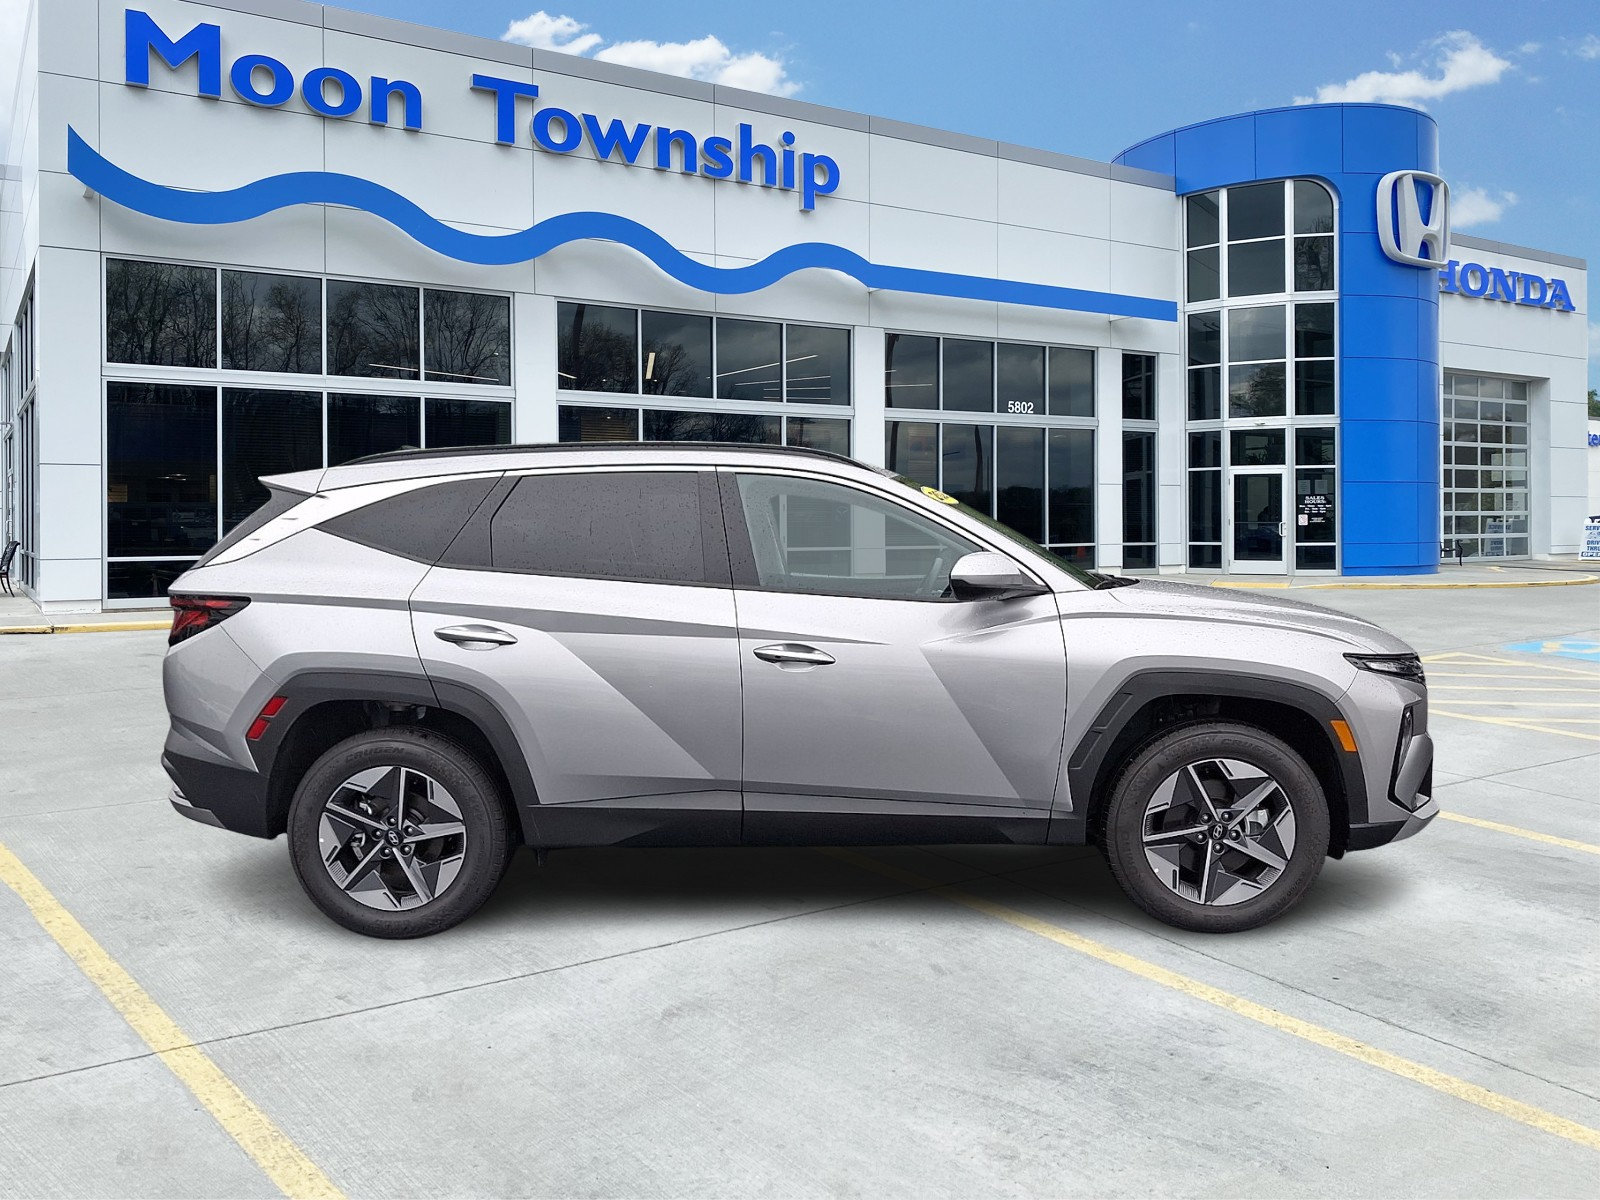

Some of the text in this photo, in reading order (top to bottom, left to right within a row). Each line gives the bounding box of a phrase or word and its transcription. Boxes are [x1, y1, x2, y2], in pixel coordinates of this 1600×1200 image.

[125, 9, 841, 212] Moon Township
[1439, 260, 1576, 312] HONDA
[1008, 400, 1034, 414] 5802
